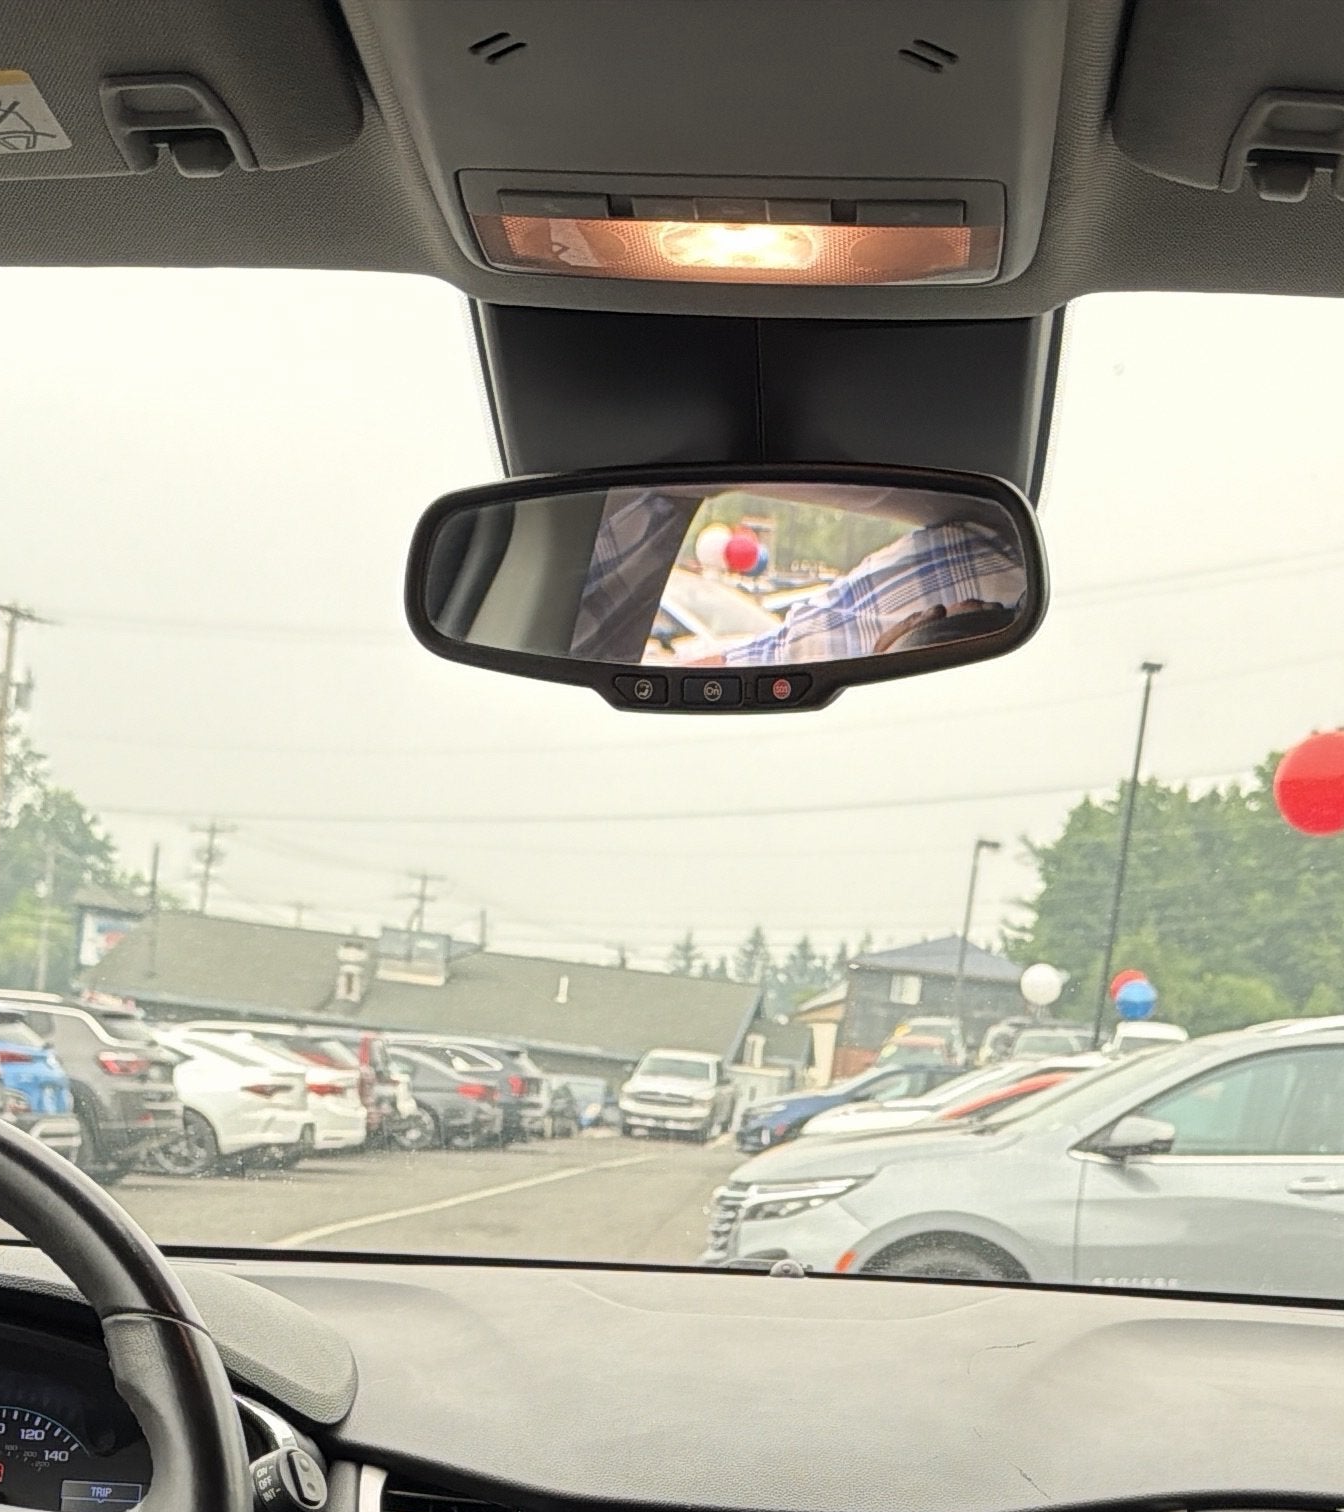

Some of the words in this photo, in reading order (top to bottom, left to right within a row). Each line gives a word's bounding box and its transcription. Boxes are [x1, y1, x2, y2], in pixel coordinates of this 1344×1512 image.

[20, 1427, 46, 1441] 120
[43, 1449, 70, 1463] 140
[90, 1485, 113, 1498] TRIP
